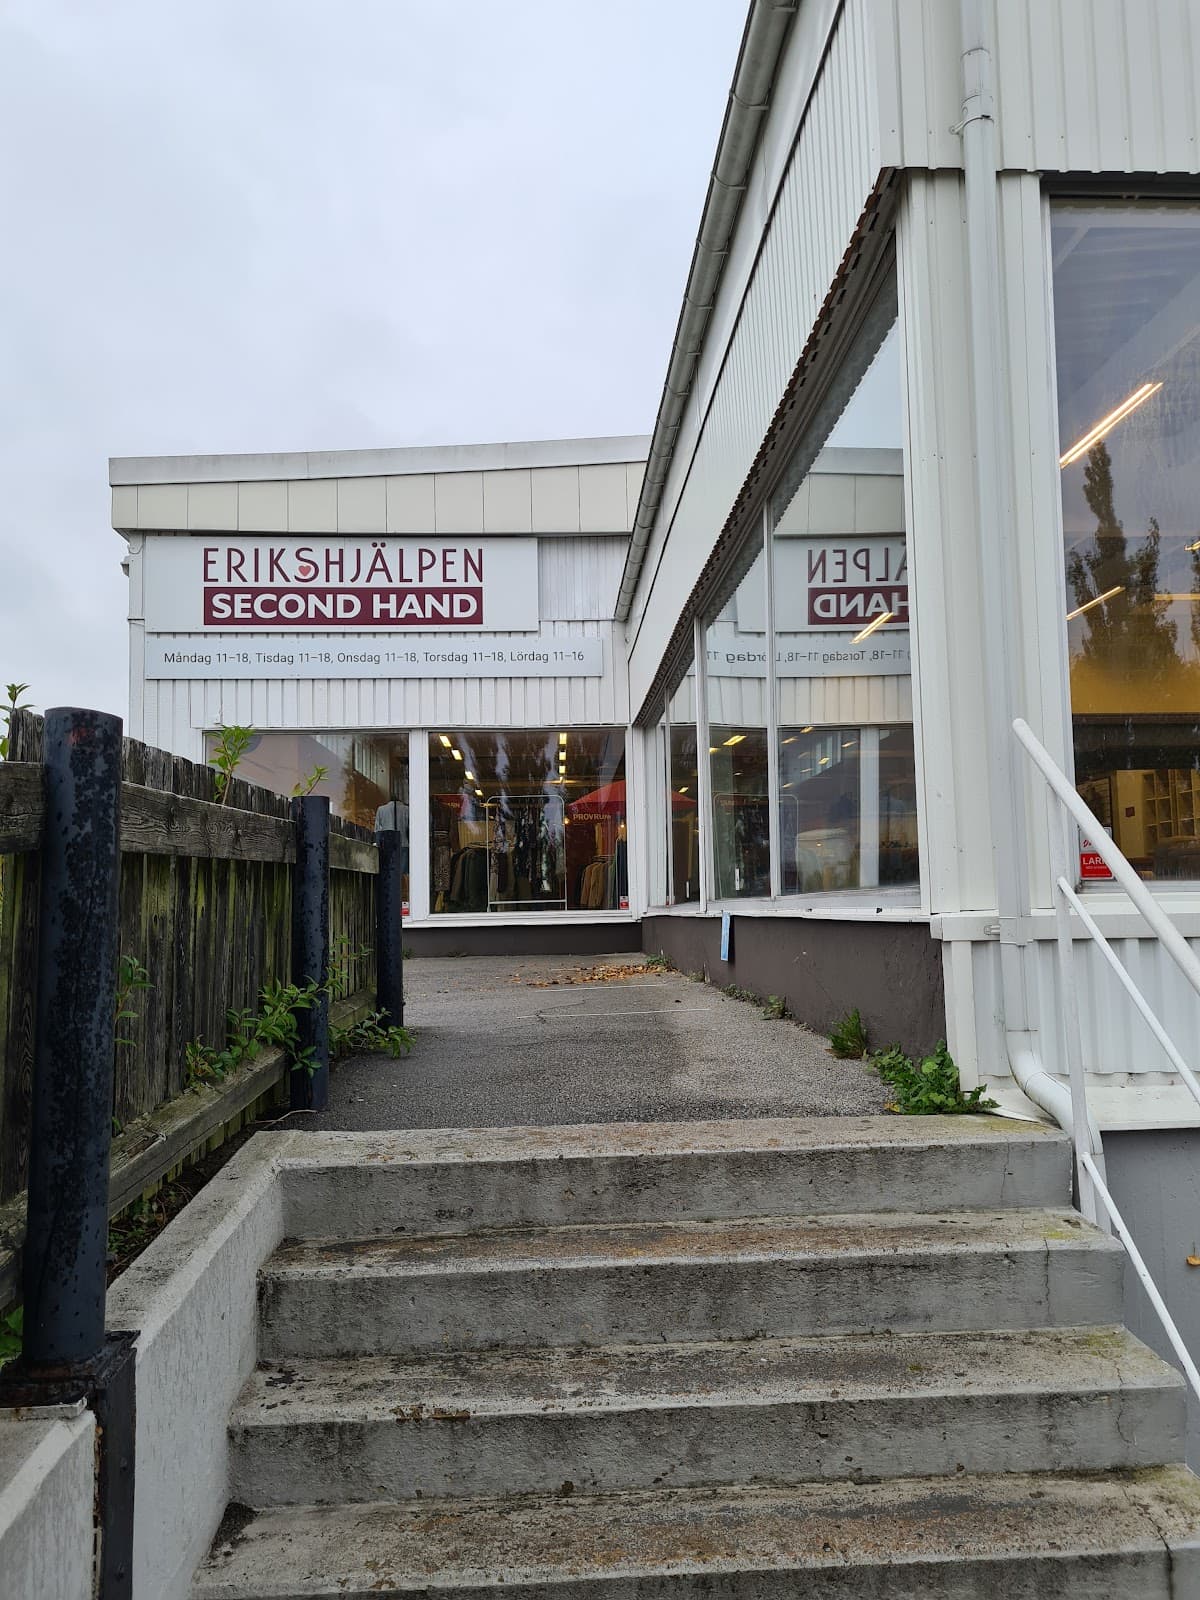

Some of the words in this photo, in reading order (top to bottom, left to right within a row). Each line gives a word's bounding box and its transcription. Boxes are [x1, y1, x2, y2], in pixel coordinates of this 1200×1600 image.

[203, 542, 484, 583] ERIKSHJÄLPEN
[212, 593, 362, 618] SECOND
[372, 593, 478, 618] HAND
[164, 652, 212, 665] Måndag
[255, 652, 294, 665] Tisdag
[337, 652, 380, 665] Onsdag
[424, 651, 468, 664] Torsdag
[510, 651, 549, 663] Lördag
[1082, 856, 1106, 865] LAR
